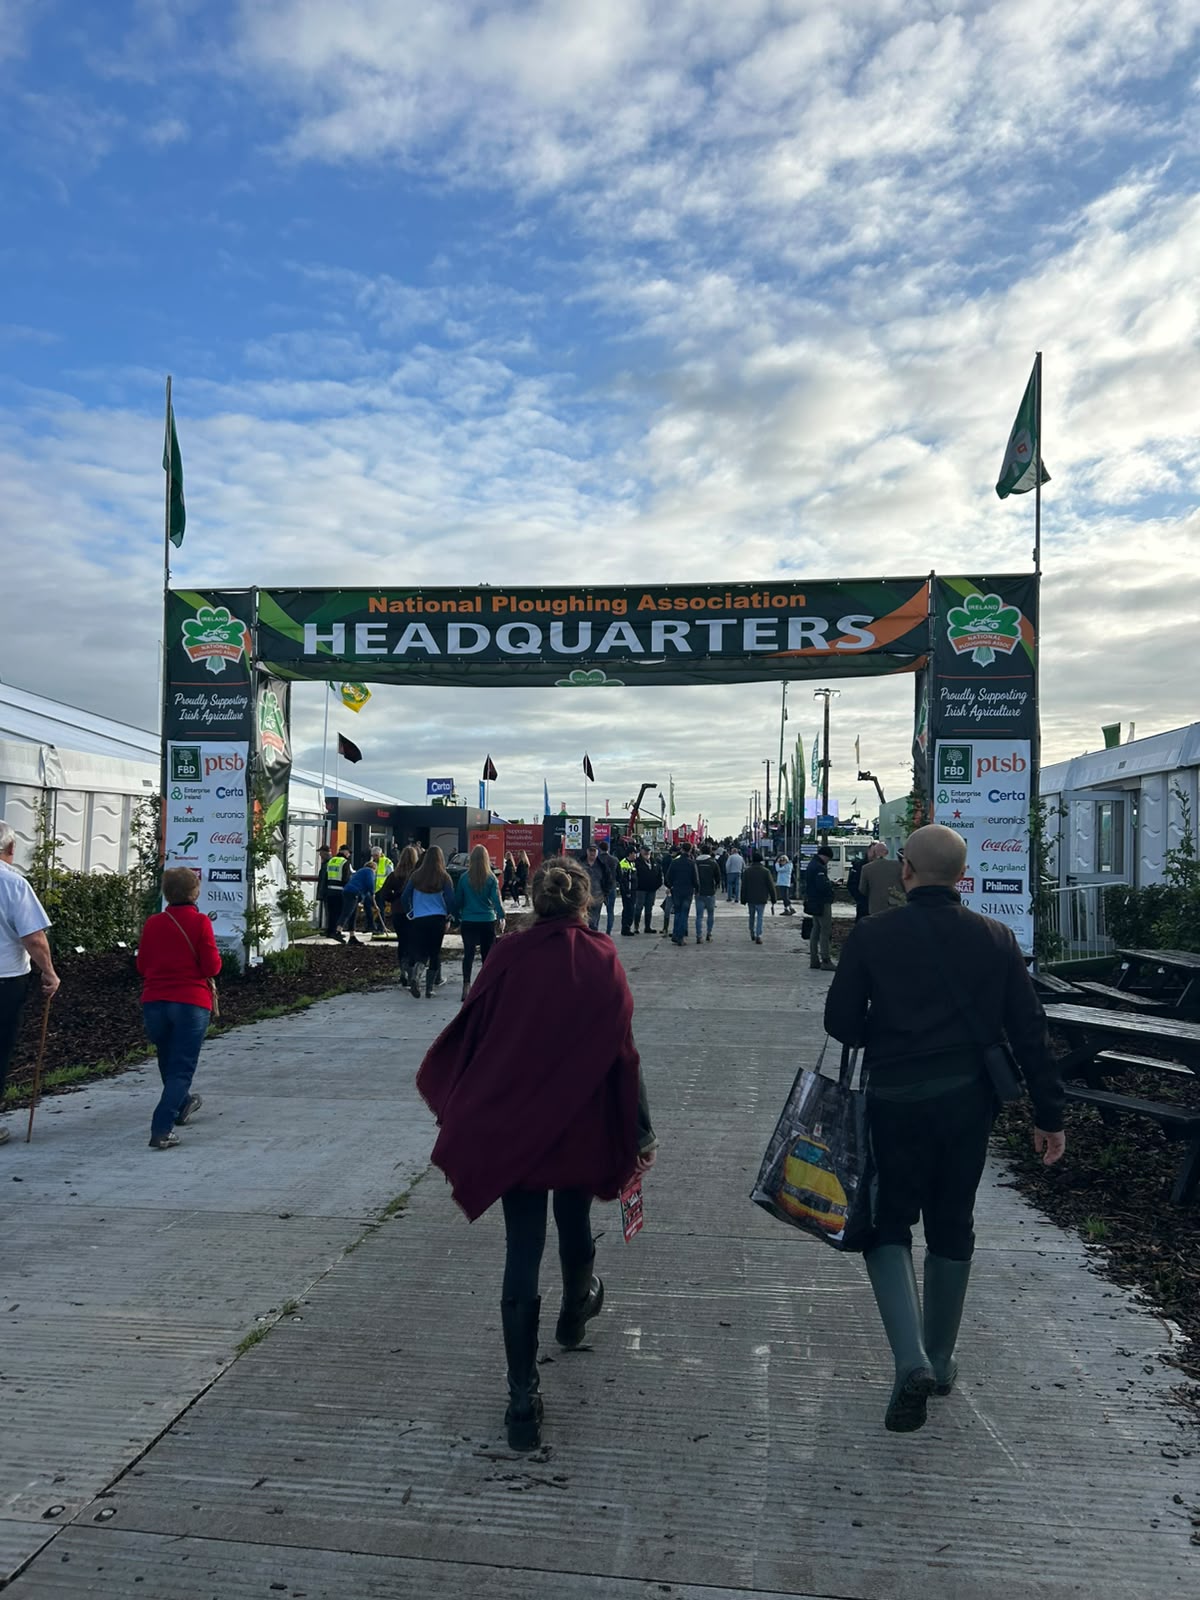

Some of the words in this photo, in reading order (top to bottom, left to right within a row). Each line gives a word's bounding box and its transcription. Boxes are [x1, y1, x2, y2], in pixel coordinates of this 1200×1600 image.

[367, 596, 482, 614] National
[491, 594, 628, 616] Ploughing
[636, 592, 807, 612] Association
[303, 613, 876, 655] HEADQUARTERS
[174, 692, 208, 710] Proudly
[209, 693, 248, 709] Supporting
[940, 687, 976, 706] Proudly
[977, 687, 1028, 705] Supporting
[178, 708, 200, 721] Irish
[201, 708, 244, 726] Agriculture
[944, 703, 967, 717] Irish
[968, 704, 1022, 722] Agriculture
[177, 765, 196, 774] FBD
[205, 752, 245, 776] ptsb
[976, 752, 1026, 778] ptsb
[943, 766, 965, 776] FBD
[183, 786, 210, 795] Enterprise
[215, 786, 244, 799] Certa
[950, 789, 981, 797] Enterprise
[988, 789, 1026, 803] Certa
[173, 815, 205, 823] Heineken
[987, 816, 1026, 825] euronics
[219, 854, 245, 864] Agriland
[991, 863, 1026, 873] Agriland
[207, 890, 243, 901] SHAWS
[980, 903, 1024, 915] SHAWS
